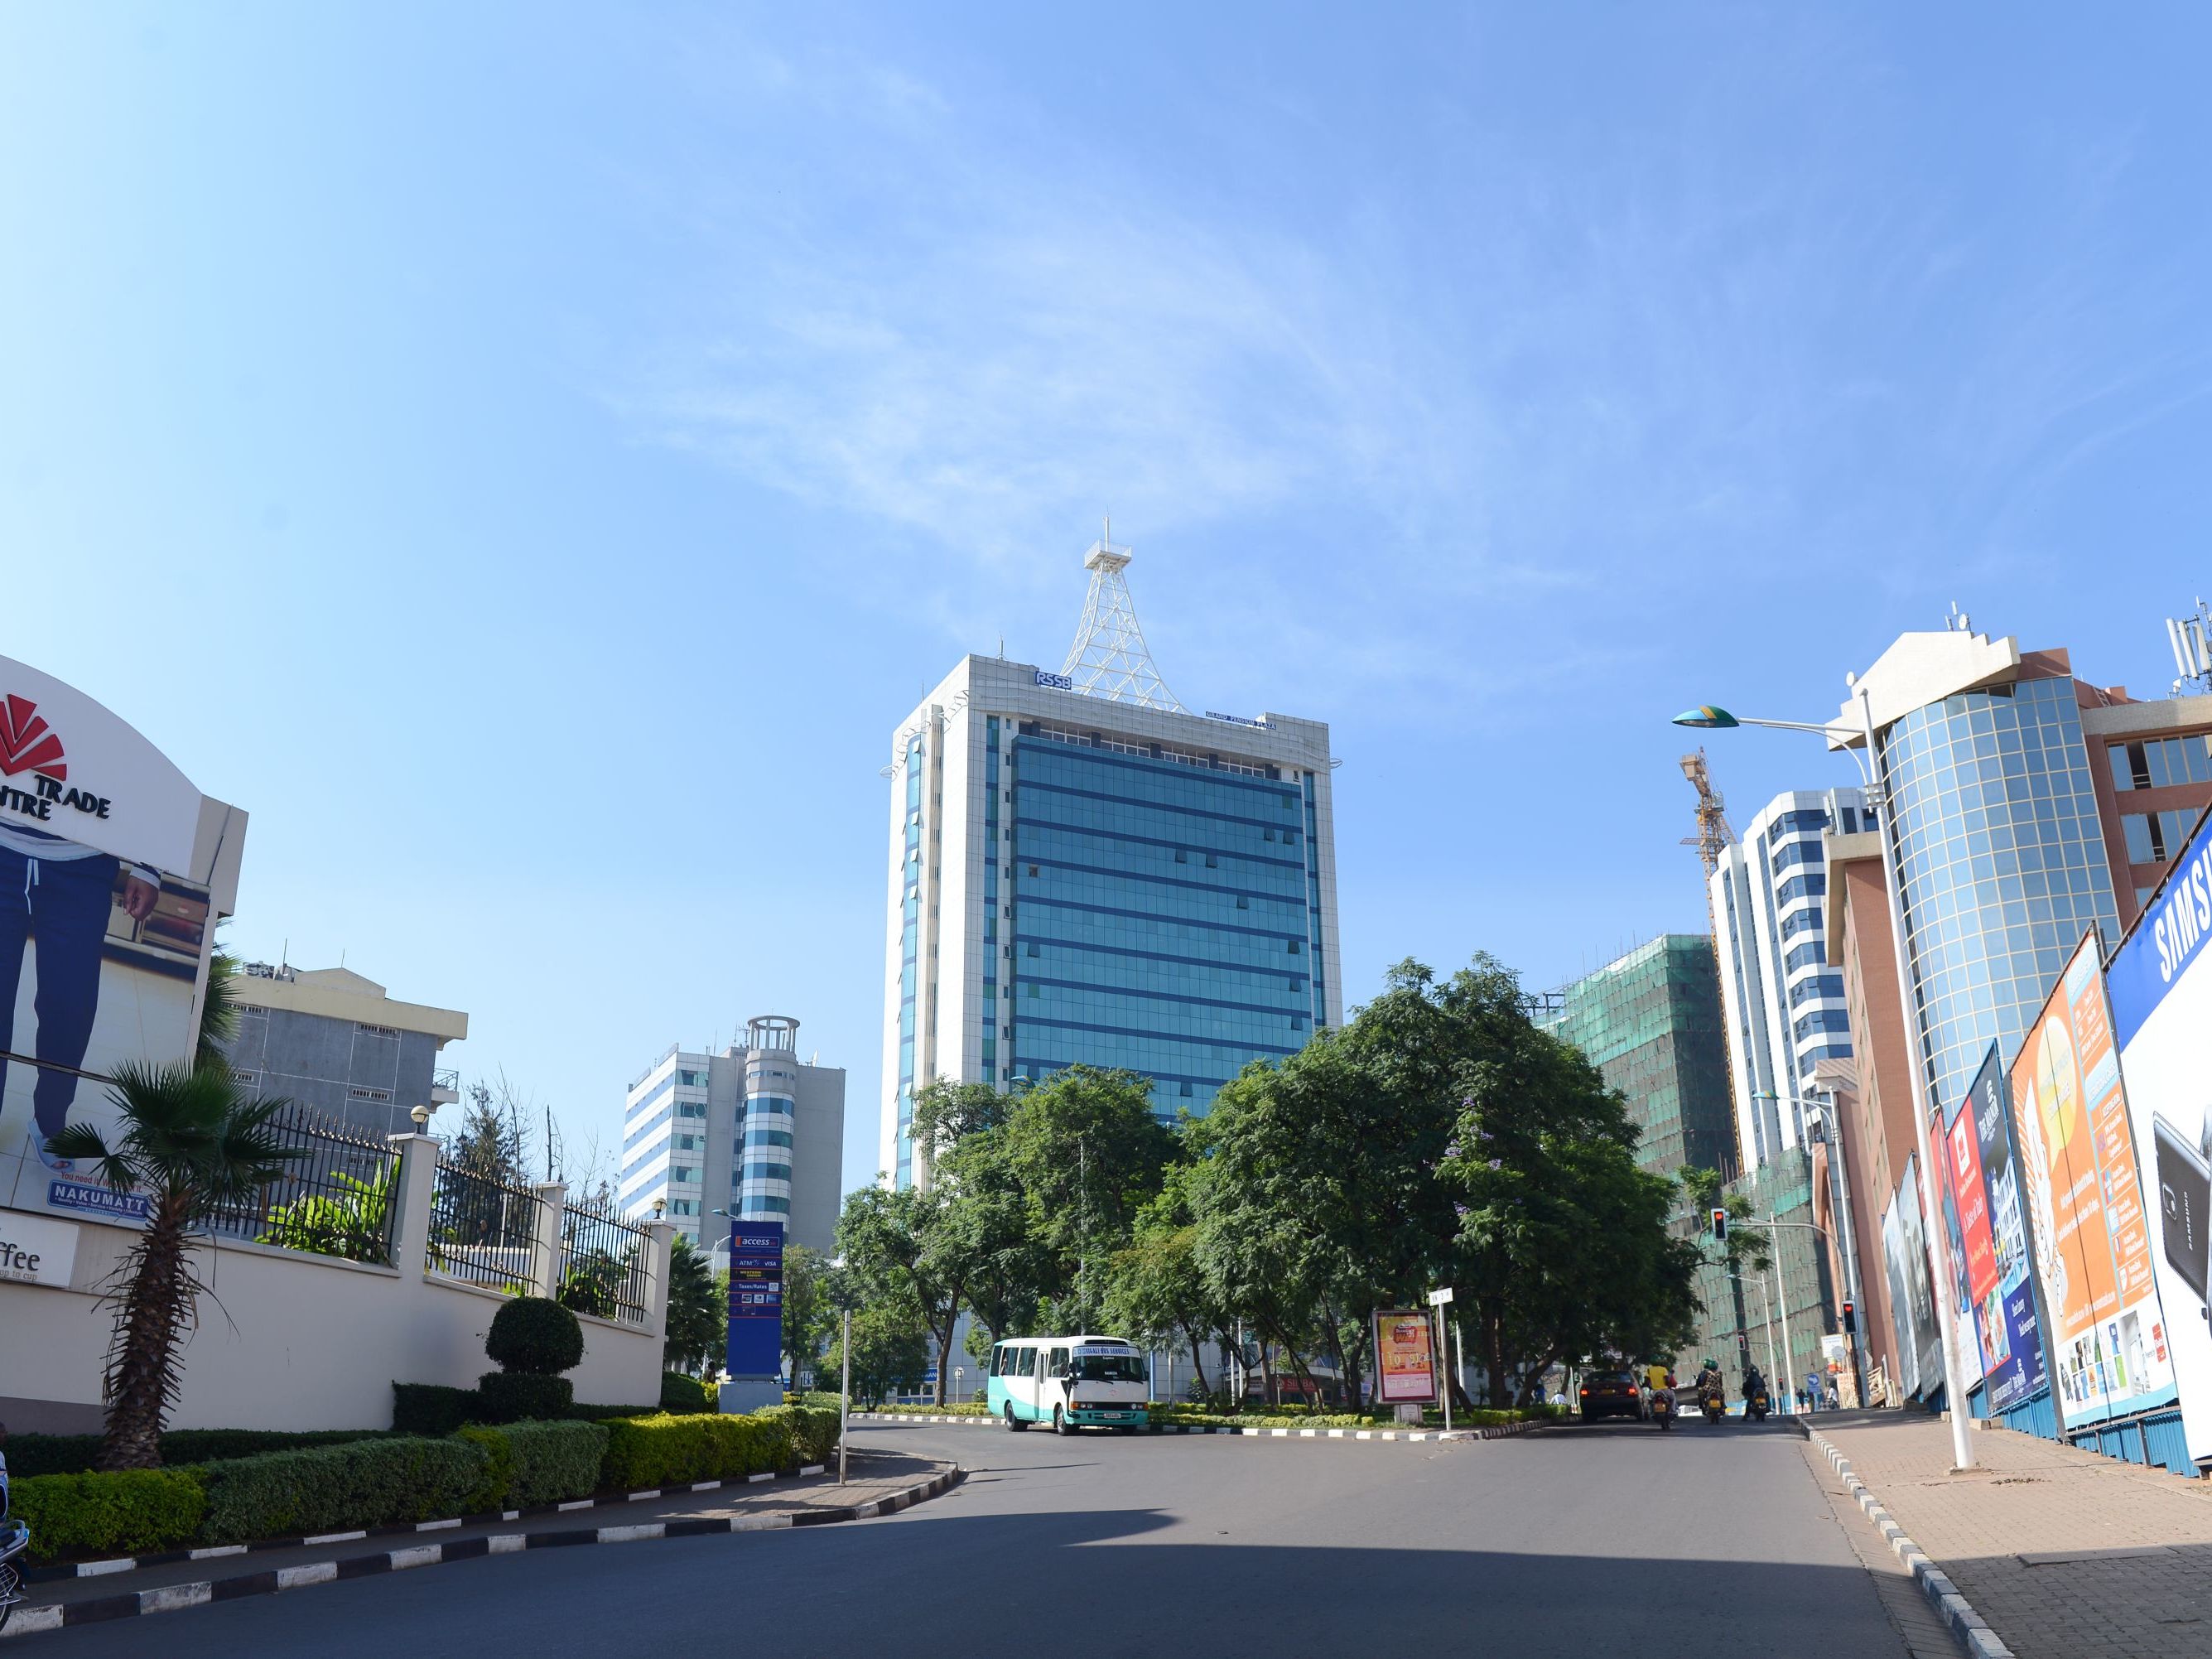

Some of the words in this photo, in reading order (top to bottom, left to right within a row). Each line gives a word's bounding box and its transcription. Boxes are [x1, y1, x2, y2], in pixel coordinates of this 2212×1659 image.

[1036, 672, 1071, 689] RSSB
[1207, 711, 1228, 721] GRAND
[1230, 716, 1255, 726] PENSION
[34, 774, 111, 820] TRADE
[61, 1171, 73, 1180] You
[75, 1174, 92, 1184] need
[55, 1185, 144, 1210] NAKUMATT
[2184, 1191, 2193, 1251] SAMSUNG
[23, 1272, 37, 1280] cup
[1287, 1378, 1315, 1387] SIBA
